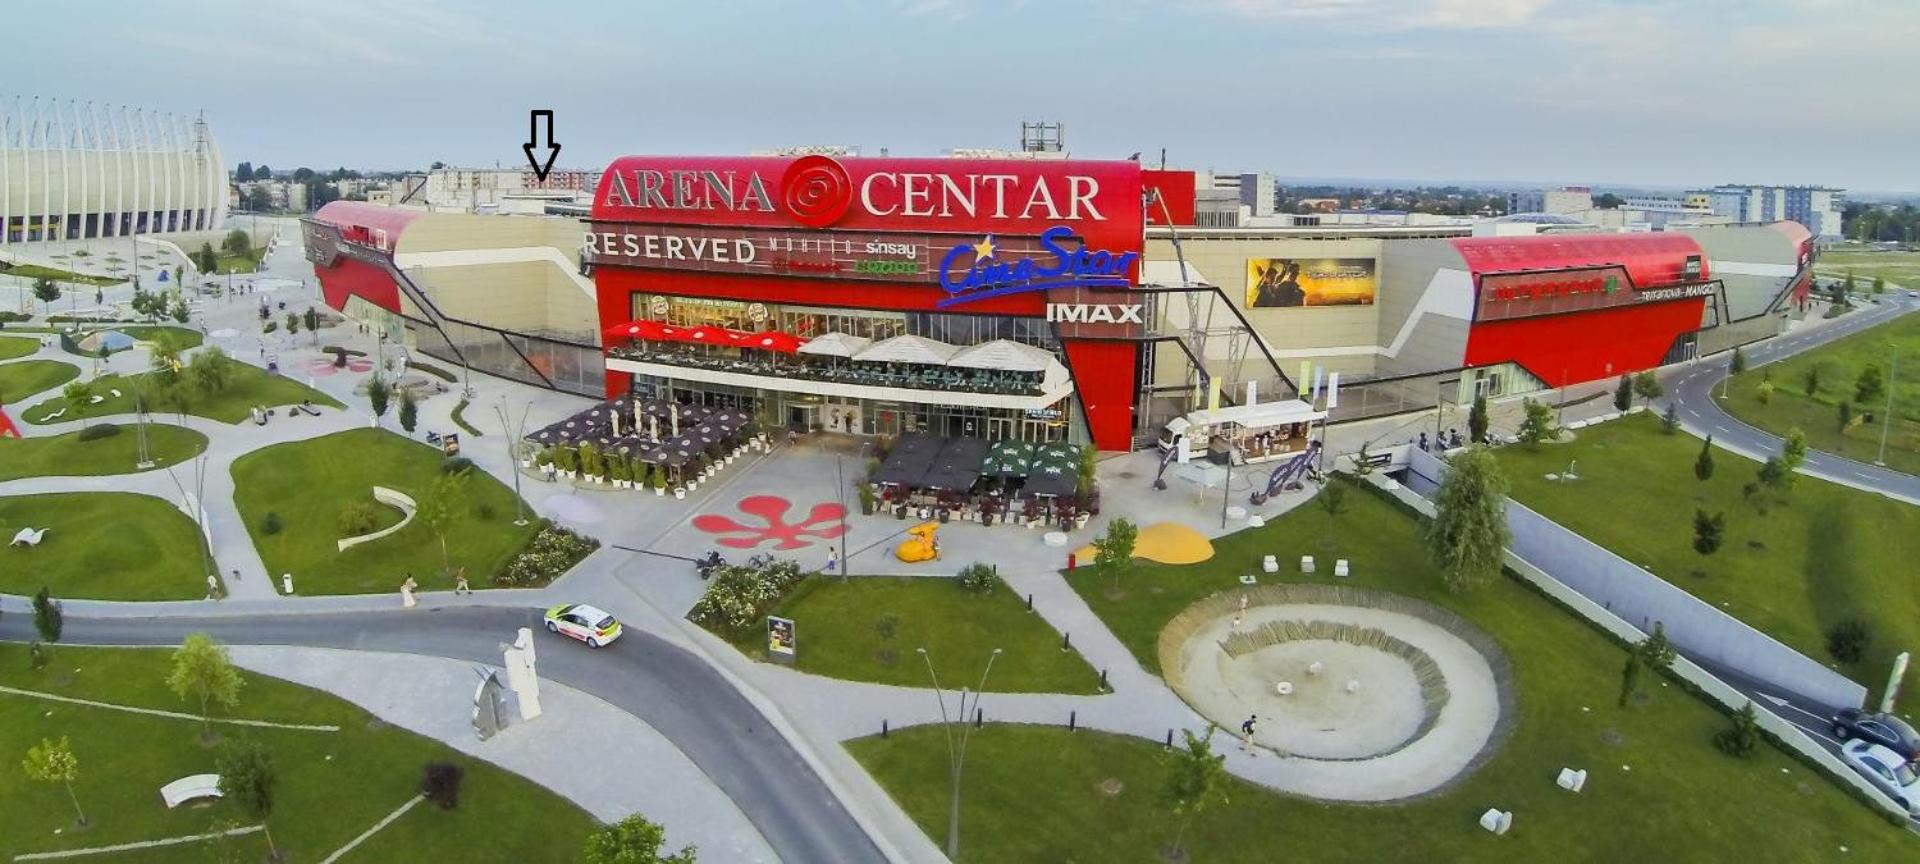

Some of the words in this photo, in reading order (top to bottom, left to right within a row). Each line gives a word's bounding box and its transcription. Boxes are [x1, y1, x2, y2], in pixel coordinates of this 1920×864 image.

[603, 168, 777, 213] ARENA
[860, 171, 1108, 221] CENTAR
[583, 231, 756, 265] RESERVED
[865, 238, 917, 260] sinsay
[1046, 303, 1144, 325] IMAX
